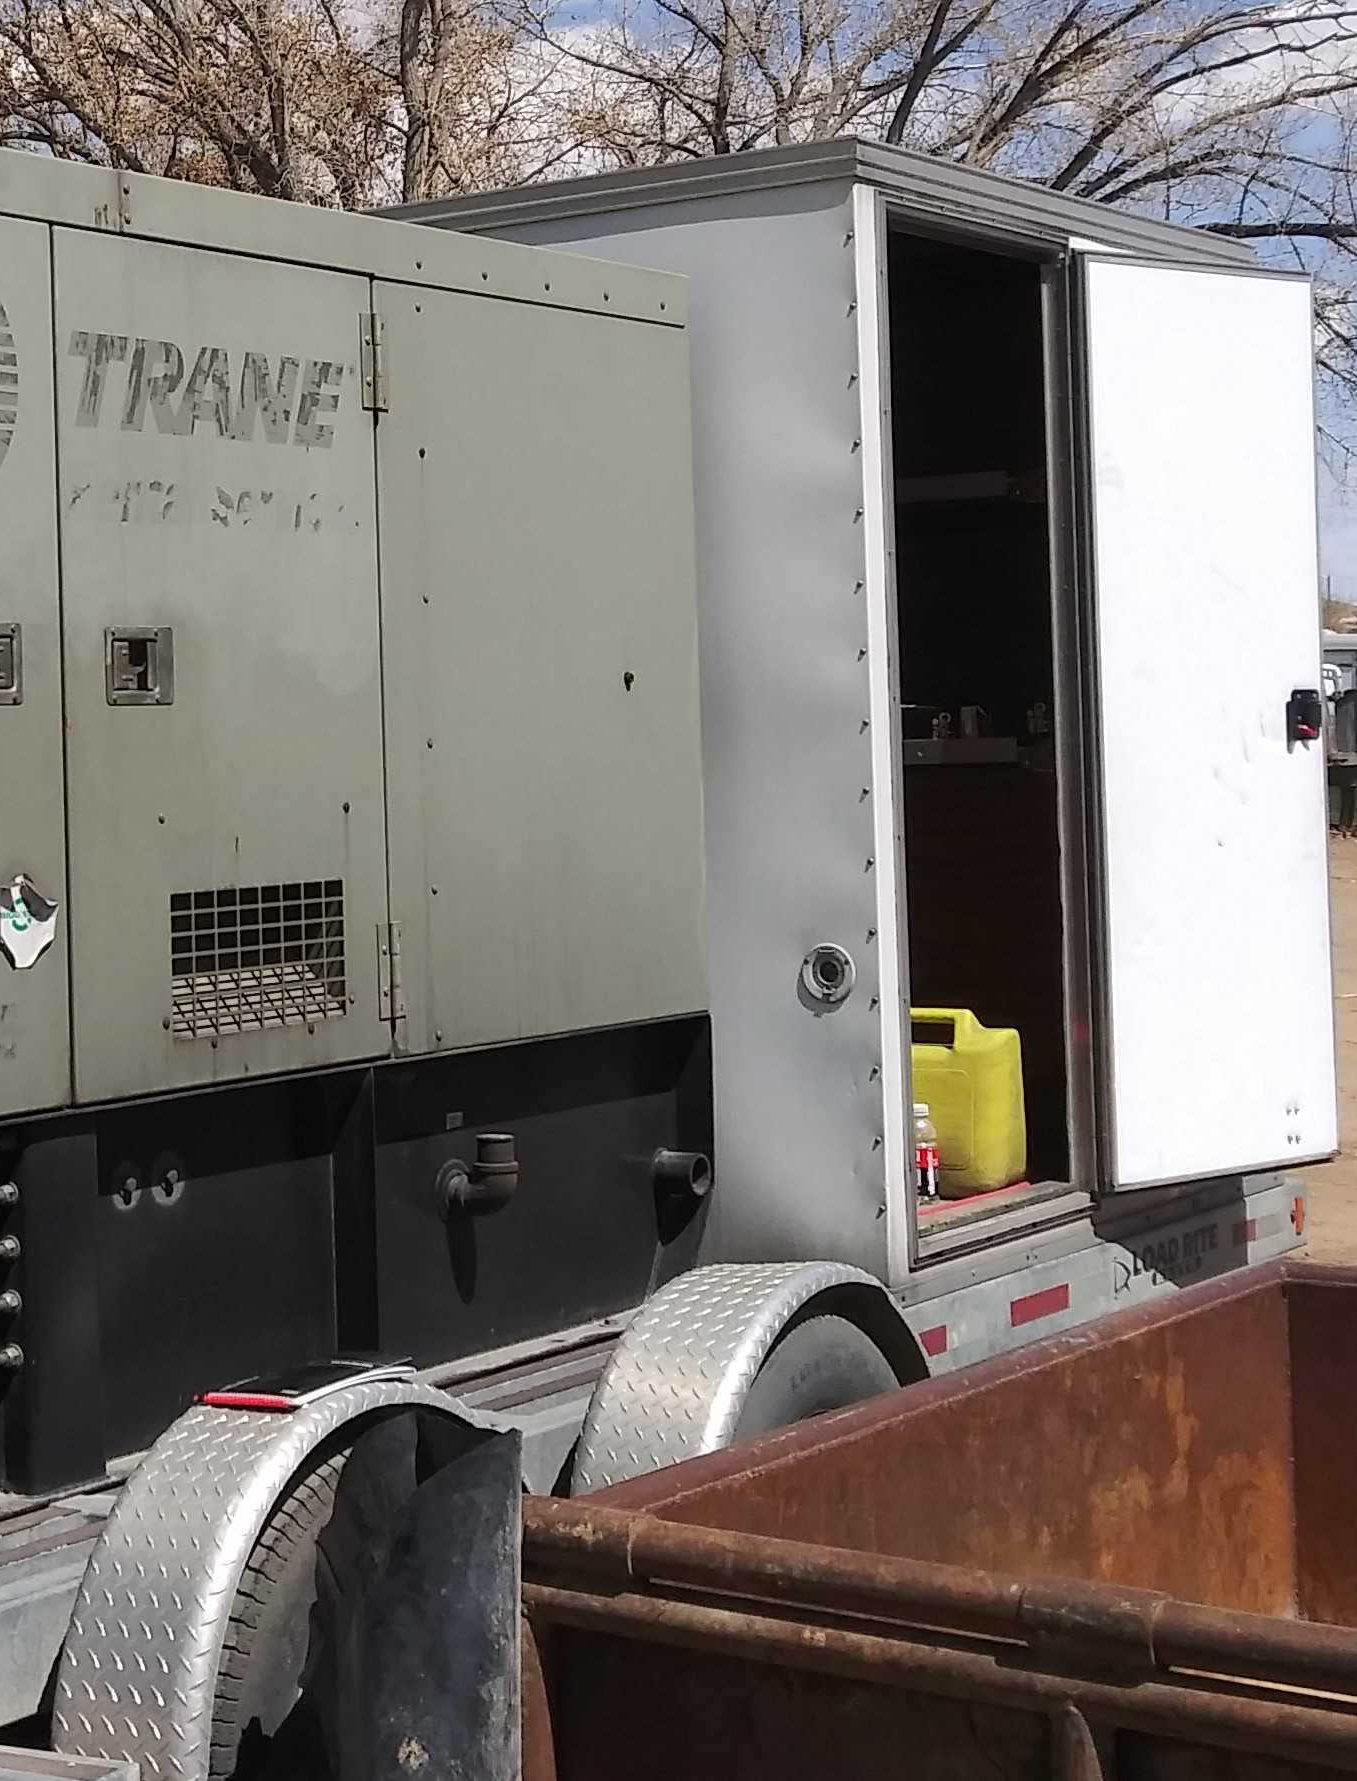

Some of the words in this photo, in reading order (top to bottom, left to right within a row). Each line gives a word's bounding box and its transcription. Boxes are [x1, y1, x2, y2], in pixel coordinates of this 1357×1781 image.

[68, 330, 344, 448] TRANE
[1133, 1238, 1180, 1276] LOAD
[1183, 1224, 1219, 1256] RITE
